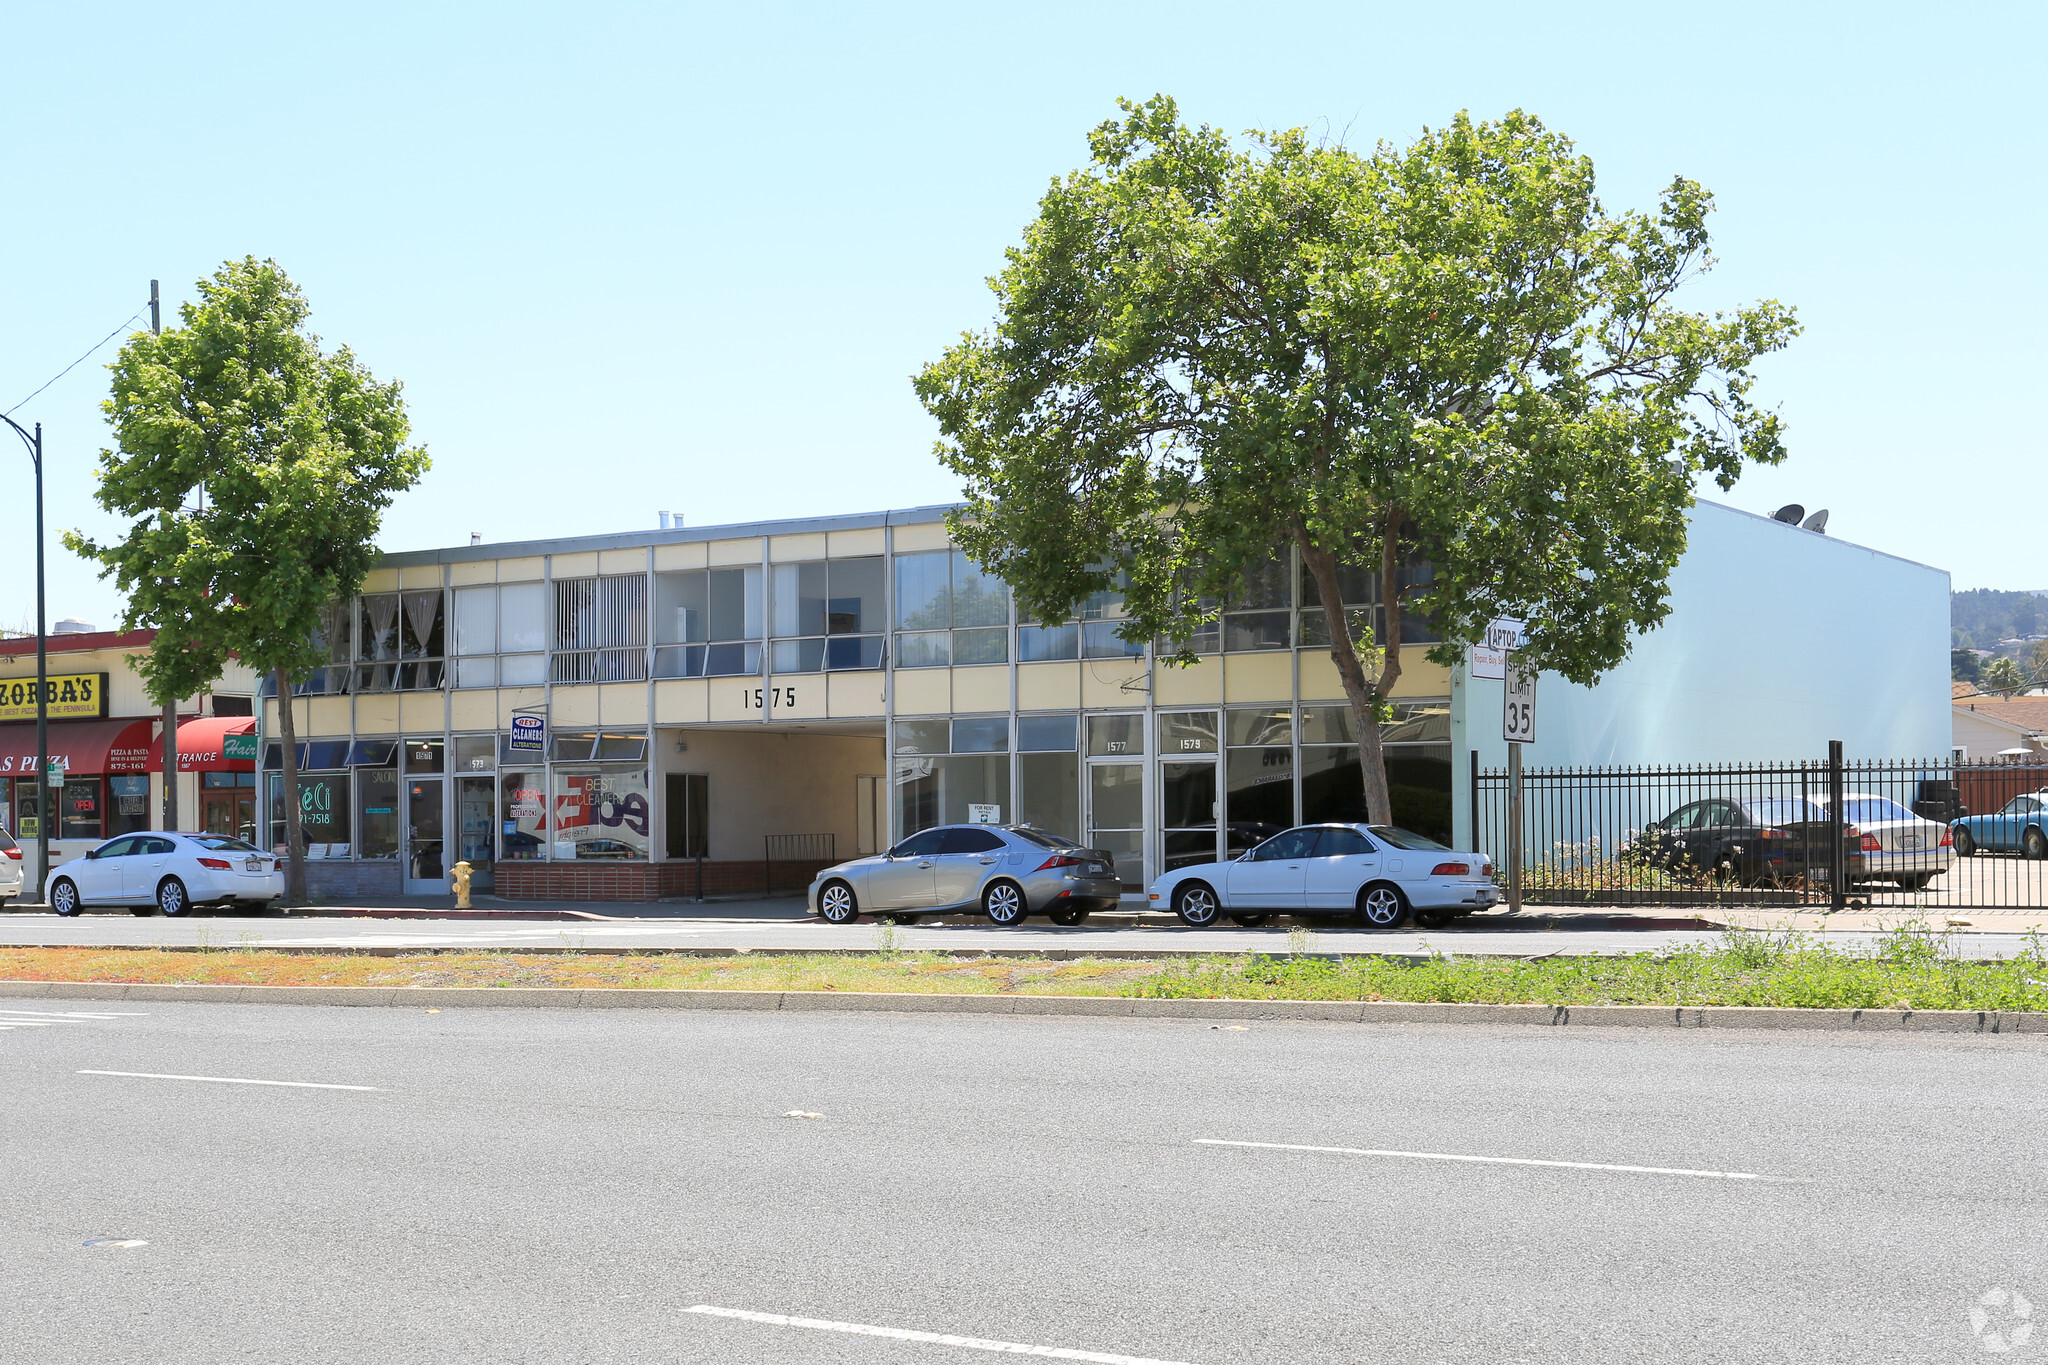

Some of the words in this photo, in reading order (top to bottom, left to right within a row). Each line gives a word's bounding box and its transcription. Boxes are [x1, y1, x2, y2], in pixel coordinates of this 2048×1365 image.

[1510, 682, 1530, 696] LIMIT
[744, 687, 795, 709] 1575
[64, 704, 96, 712] PENINSULA
[1508, 702, 1530, 734] 35
[513, 728, 542, 741] CLEANERS
[224, 739, 256, 755] Hair
[513, 741, 542, 749] ALTERATIONS
[1107, 742, 1126, 751] 1577
[1180, 739, 1201, 750] 1579
[585, 778, 615, 791] BEST
[515, 789, 541, 801] OPEN
[576, 793, 626, 806] CLEANERS
[74, 800, 95, 811] OPEN
